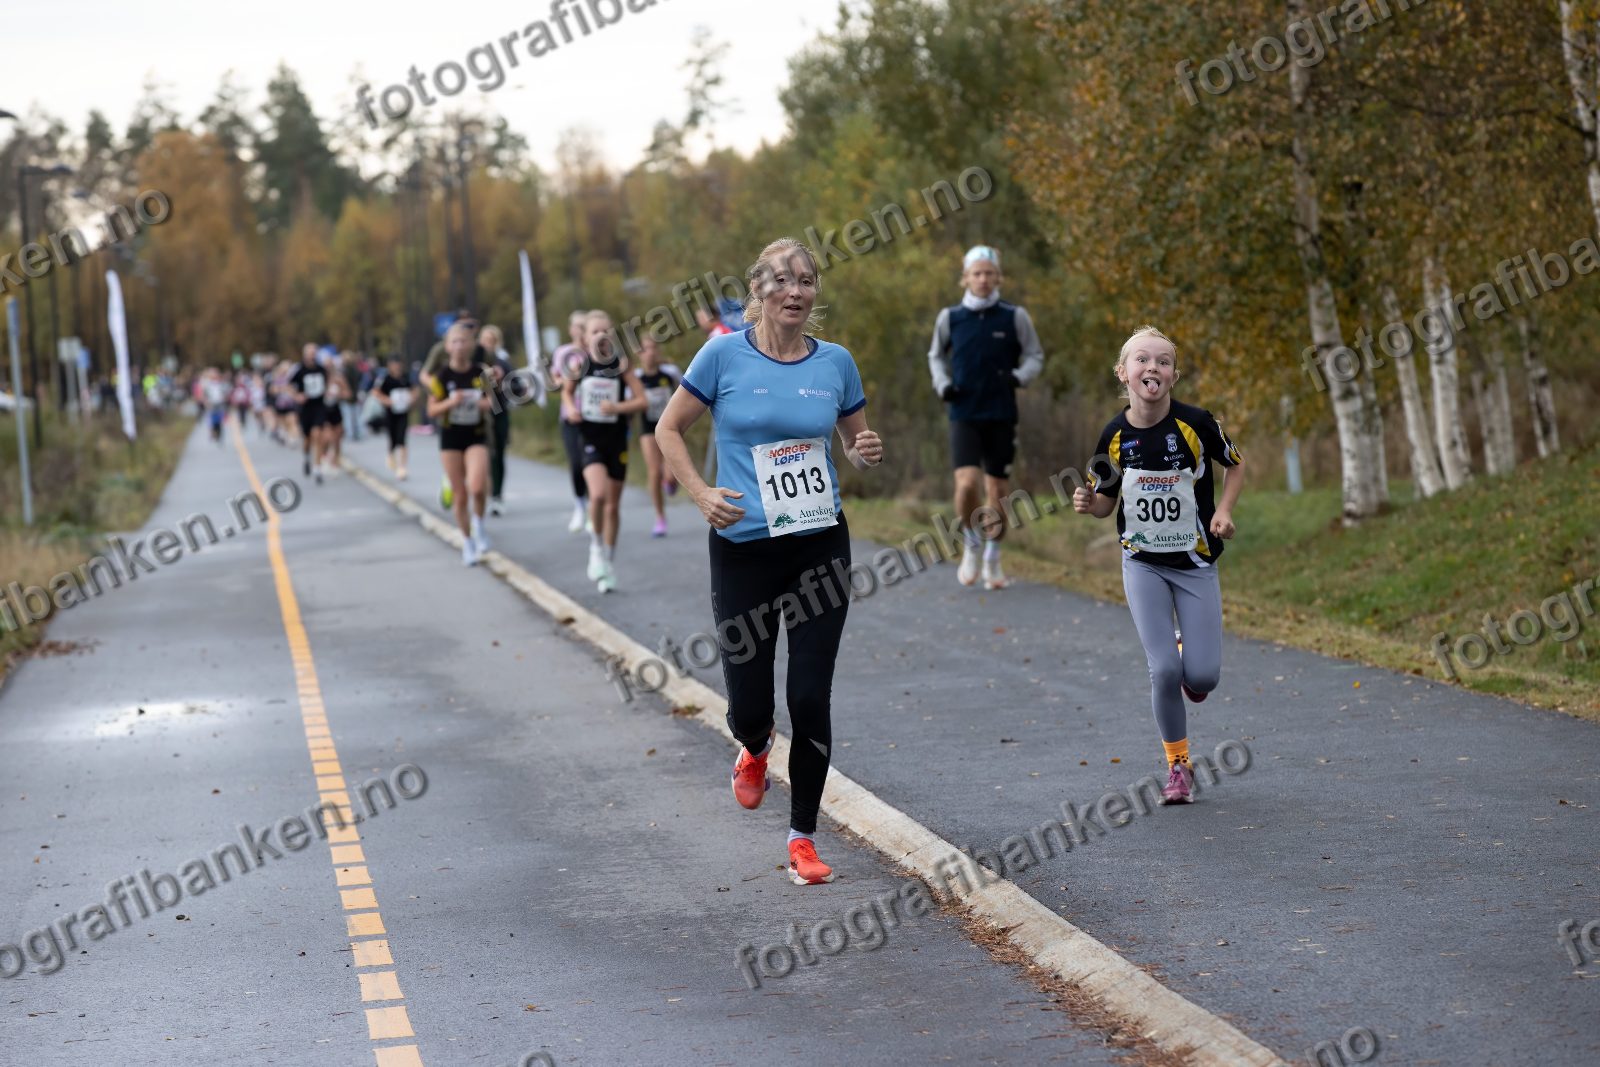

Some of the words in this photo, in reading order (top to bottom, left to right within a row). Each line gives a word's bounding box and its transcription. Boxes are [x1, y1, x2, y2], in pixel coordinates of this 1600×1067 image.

[806, 388, 831, 397] HALDEN
[769, 443, 812, 458] NORGES
[774, 452, 806, 466] LØPET
[766, 467, 826, 501] 1013
[1137, 475, 1180, 484] NORGES
[1141, 483, 1175, 492] LØPET
[799, 505, 834, 518] Aurskog
[1136, 497, 1181, 523] 309
[1153, 532, 1195, 542] Aurskog
